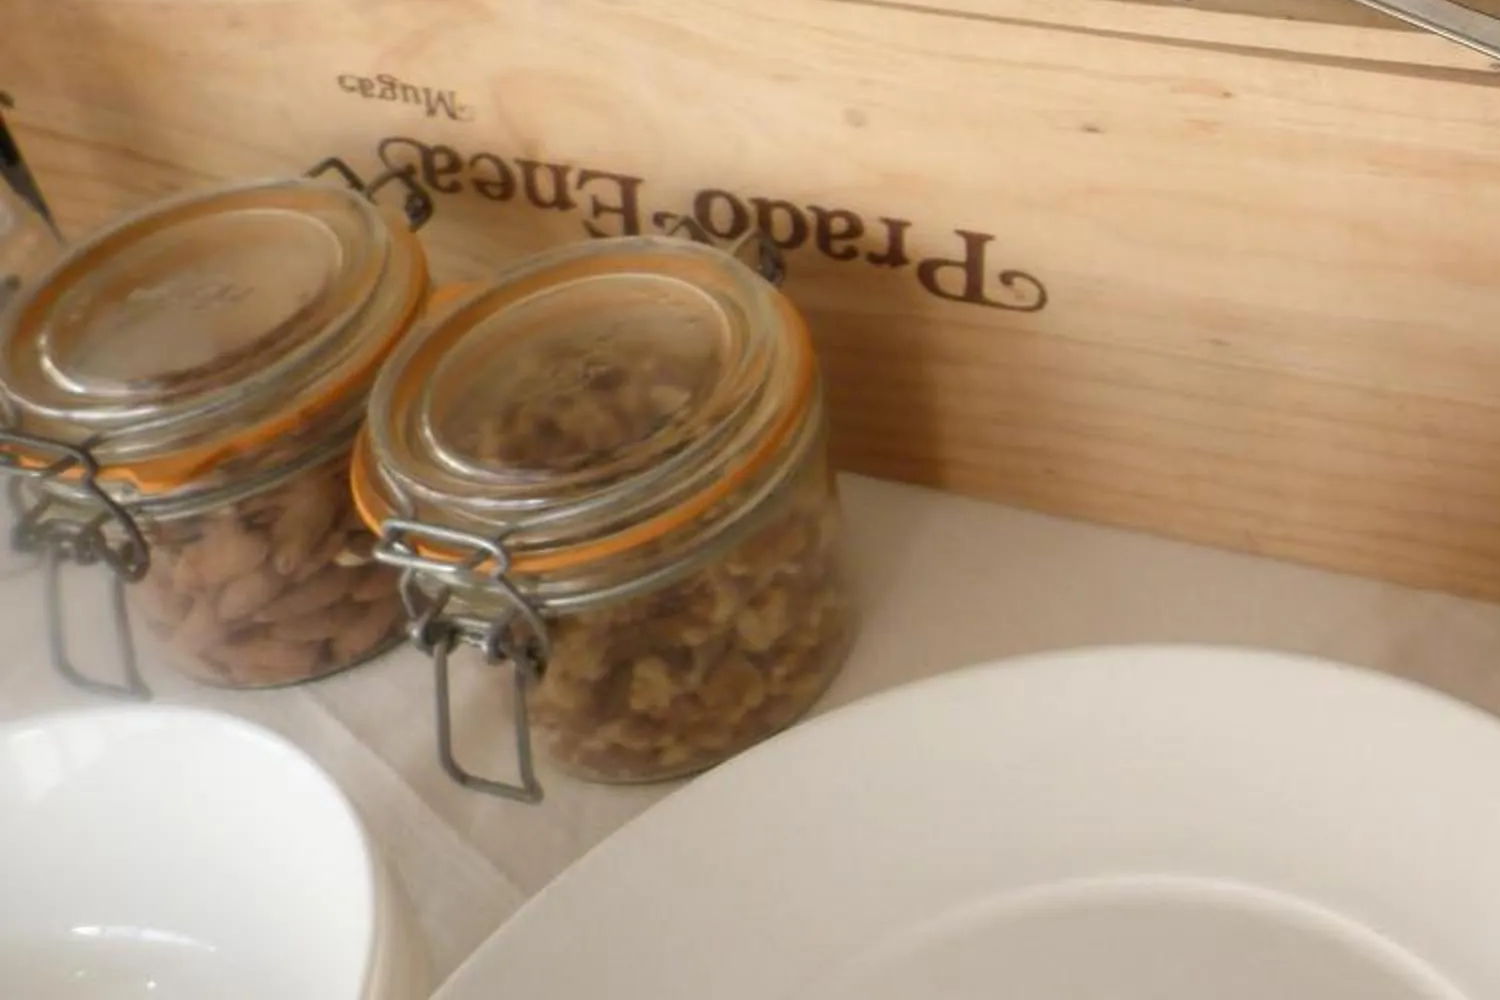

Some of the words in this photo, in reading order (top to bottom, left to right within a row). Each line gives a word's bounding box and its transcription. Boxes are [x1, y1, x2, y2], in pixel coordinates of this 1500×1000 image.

[337, 74, 472, 121] Muga
[378, 137, 644, 237] Enea
[653, 189, 1048, 312] Prado
